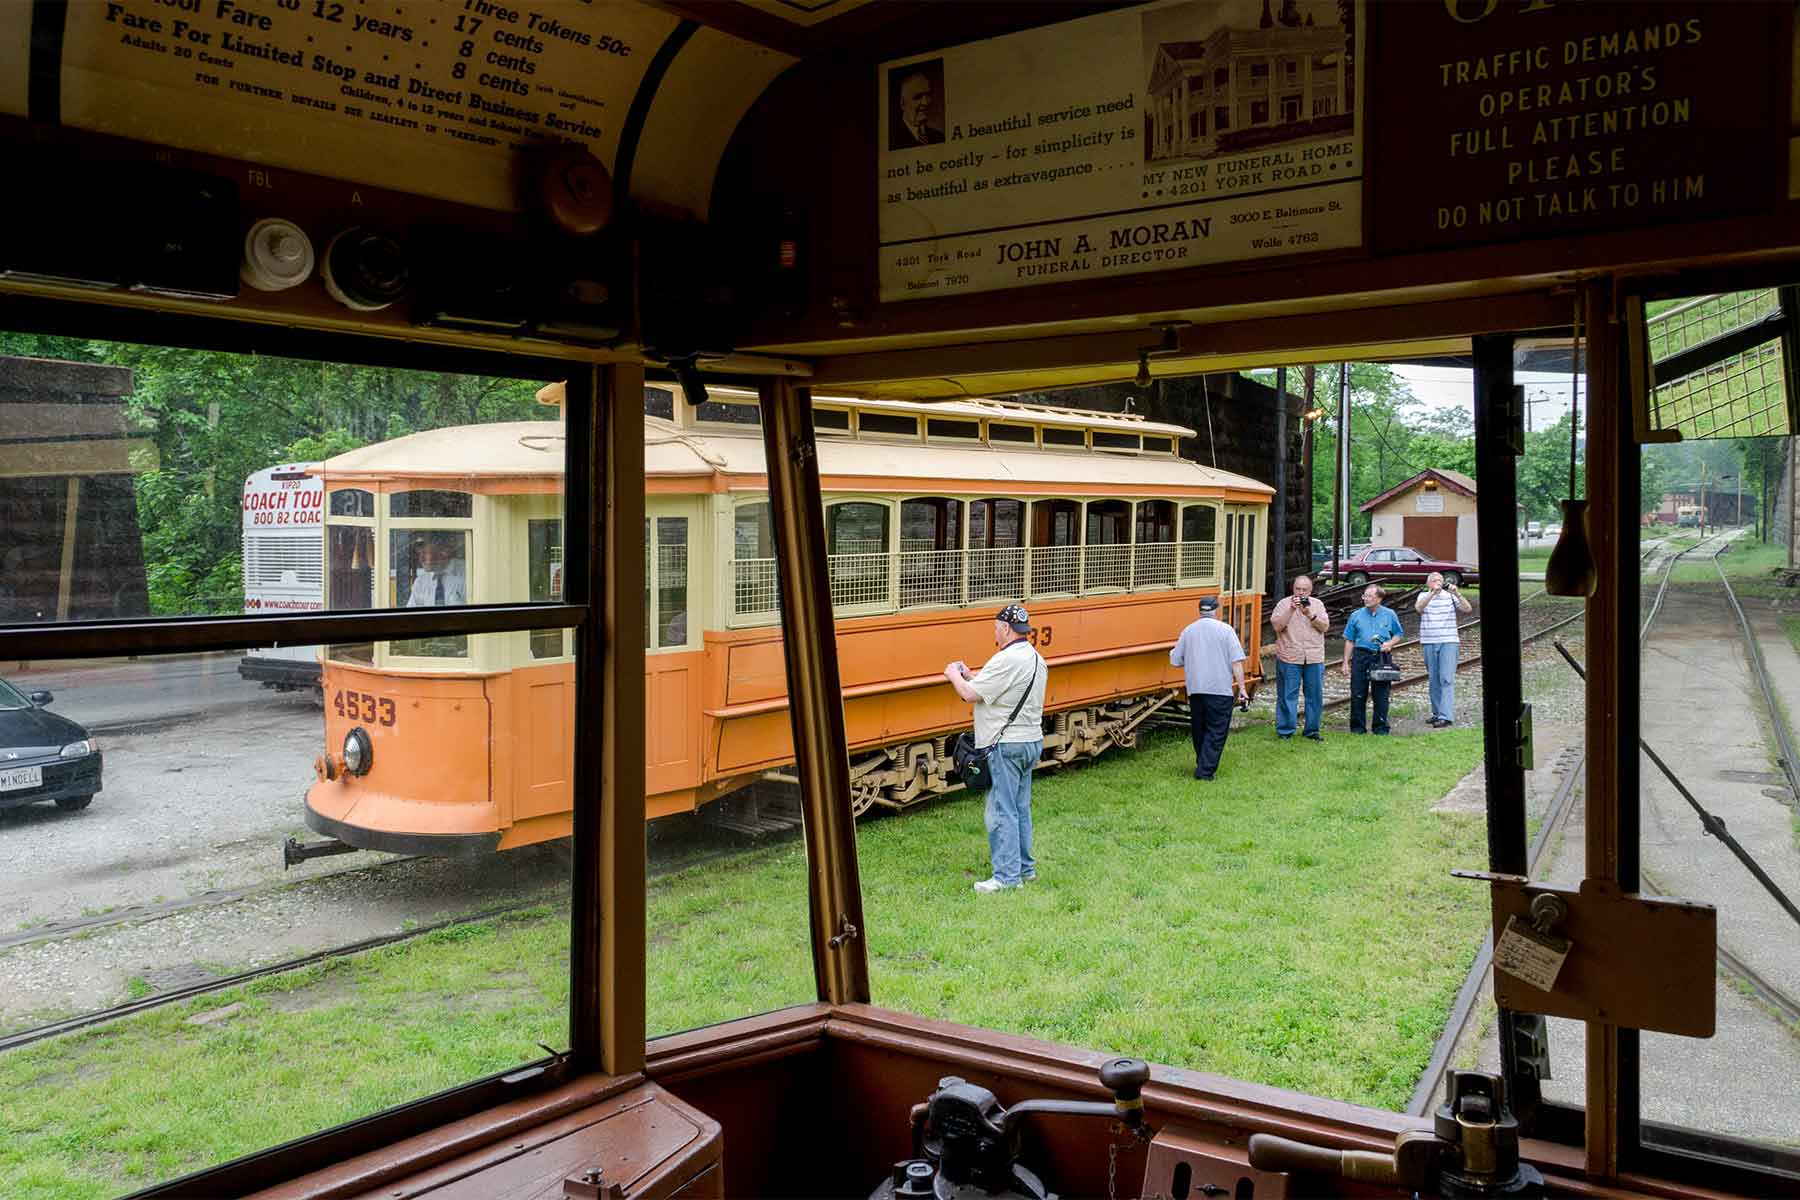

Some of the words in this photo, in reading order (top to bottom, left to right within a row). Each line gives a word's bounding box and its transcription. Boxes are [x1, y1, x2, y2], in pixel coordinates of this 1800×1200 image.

[121, 33, 167, 54] Adults
[174, 46, 193, 59] 20
[216, 0, 272, 30] Fare
[452, 62, 467, 80] 8
[479, 71, 530, 97] cents
[312, 0, 344, 22] 12
[353, 15, 413, 42] years
[459, 41, 474, 58] 8
[486, 49, 537, 75] cents
[454, 14, 484, 35] 17
[494, 27, 544, 54] cents
[528, 12, 591, 46] Tokens
[597, 35, 632, 57] 50c
[1440, 44, 1552, 89] TRAFFIC
[1564, 18, 1704, 66] DEMANDS
[105, 3, 163, 33] Fare
[173, 20, 211, 46] For
[221, 32, 304, 68] Limited
[312, 54, 356, 81] Stop
[364, 71, 401, 90] and
[408, 78, 464, 105] Direct
[468, 93, 540, 124] Business
[544, 111, 602, 139] Service
[195, 72, 219, 86] FOR
[230, 79, 283, 100] FURTHER
[1478, 63, 1658, 121] OPERATOR'S
[422, 103, 434, 114] 12
[950, 125, 964, 142] A
[968, 112, 1031, 138] beautiful
[1037, 106, 1091, 126] service
[1096, 93, 1134, 114] need
[1449, 125, 1514, 158] FULL
[1531, 96, 1693, 145] ATTENTION
[887, 164, 911, 179] not
[916, 159, 933, 174] be
[939, 152, 984, 172] costly
[1007, 143, 1028, 160] for
[1033, 131, 1115, 156] simplicity
[1121, 126, 1136, 140] is
[1143, 171, 1165, 187] MY
[1173, 164, 1209, 182] NEW
[1216, 151, 1295, 174] FUNERAL
[1303, 141, 1354, 161] HOME
[1506, 146, 1626, 185] PLEASE
[887, 191, 901, 204] as
[906, 180, 968, 201] beautiful
[973, 179, 988, 192] as
[994, 162, 1093, 188] extravagance
[1170, 183, 1208, 198] 4201
[1216, 171, 1263, 191] YORK
[1272, 164, 1322, 182] ROAD
[1436, 204, 1469, 231] DO
[1478, 198, 1522, 226] NOT
[1534, 185, 1599, 217] TALK
[1607, 182, 1641, 209] TO
[1651, 173, 1706, 207] HIM
[1229, 212, 1260, 225] 3000
[1275, 205, 1325, 219] Baltimore
[927, 253, 950, 264] York
[956, 248, 982, 260] Road
[996, 237, 1062, 264] JOHN
[1073, 234, 1097, 255] A.
[1109, 217, 1212, 250] MORAN
[1016, 259, 1091, 278] FUNERAL
[1101, 246, 1188, 267] DIRECTOR
[243, 491, 289, 510] COACH
[293, 490, 323, 509] TOU
[254, 511, 274, 525] 800
[277, 511, 290, 525] 82
[293, 510, 321, 525] COAC
[333, 690, 397, 728] 4533
